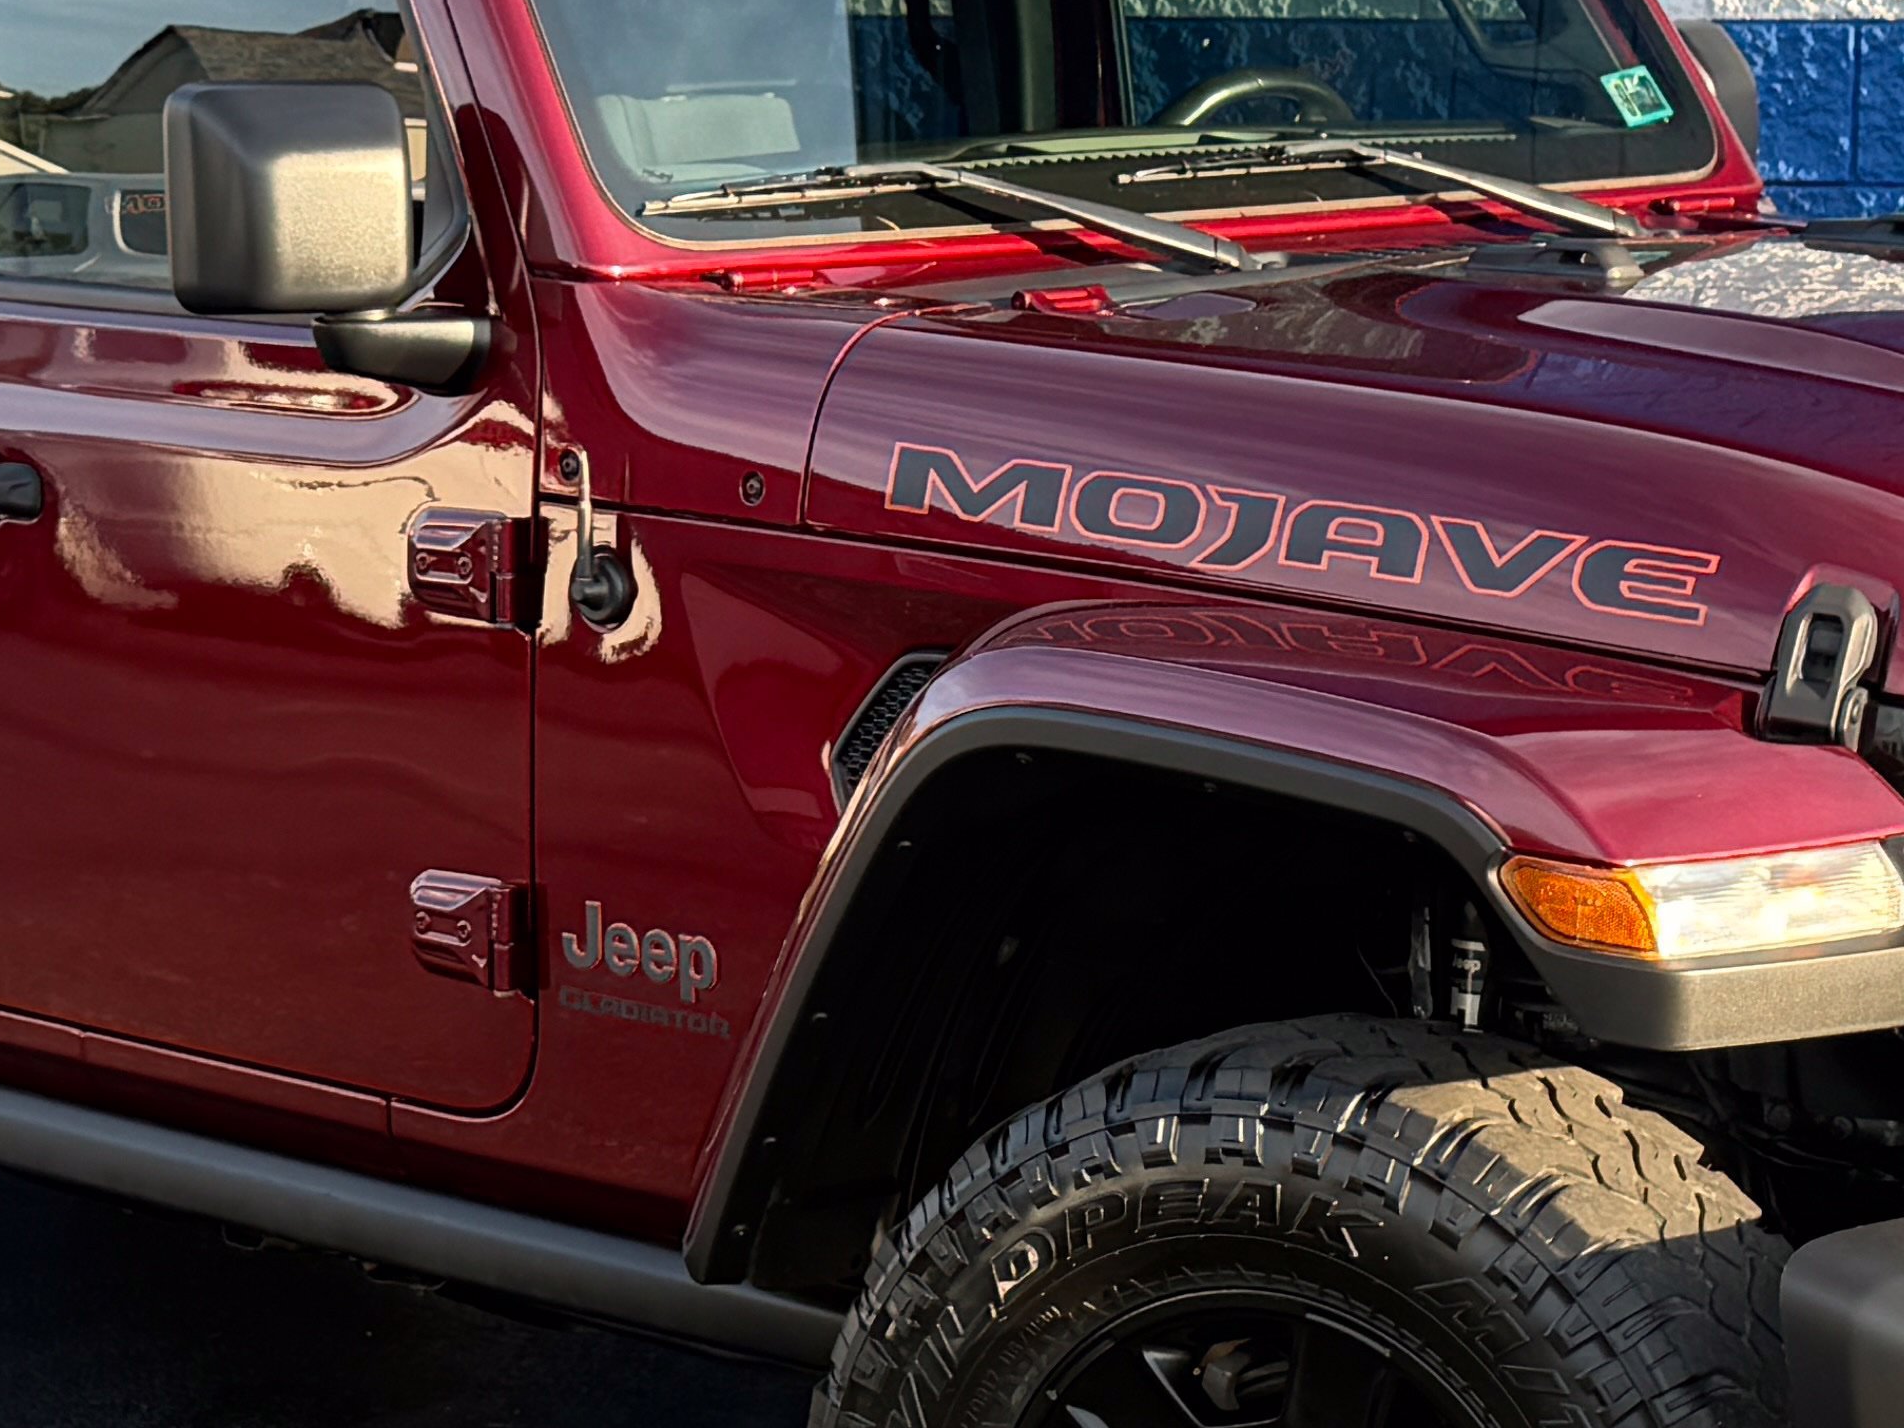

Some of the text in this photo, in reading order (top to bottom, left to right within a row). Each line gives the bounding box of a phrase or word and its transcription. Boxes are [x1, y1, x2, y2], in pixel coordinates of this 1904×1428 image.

[885, 442, 1721, 625] MOJAVE
[562, 900, 718, 1003] Jeep
[559, 984, 731, 1039] GLADIATOR
